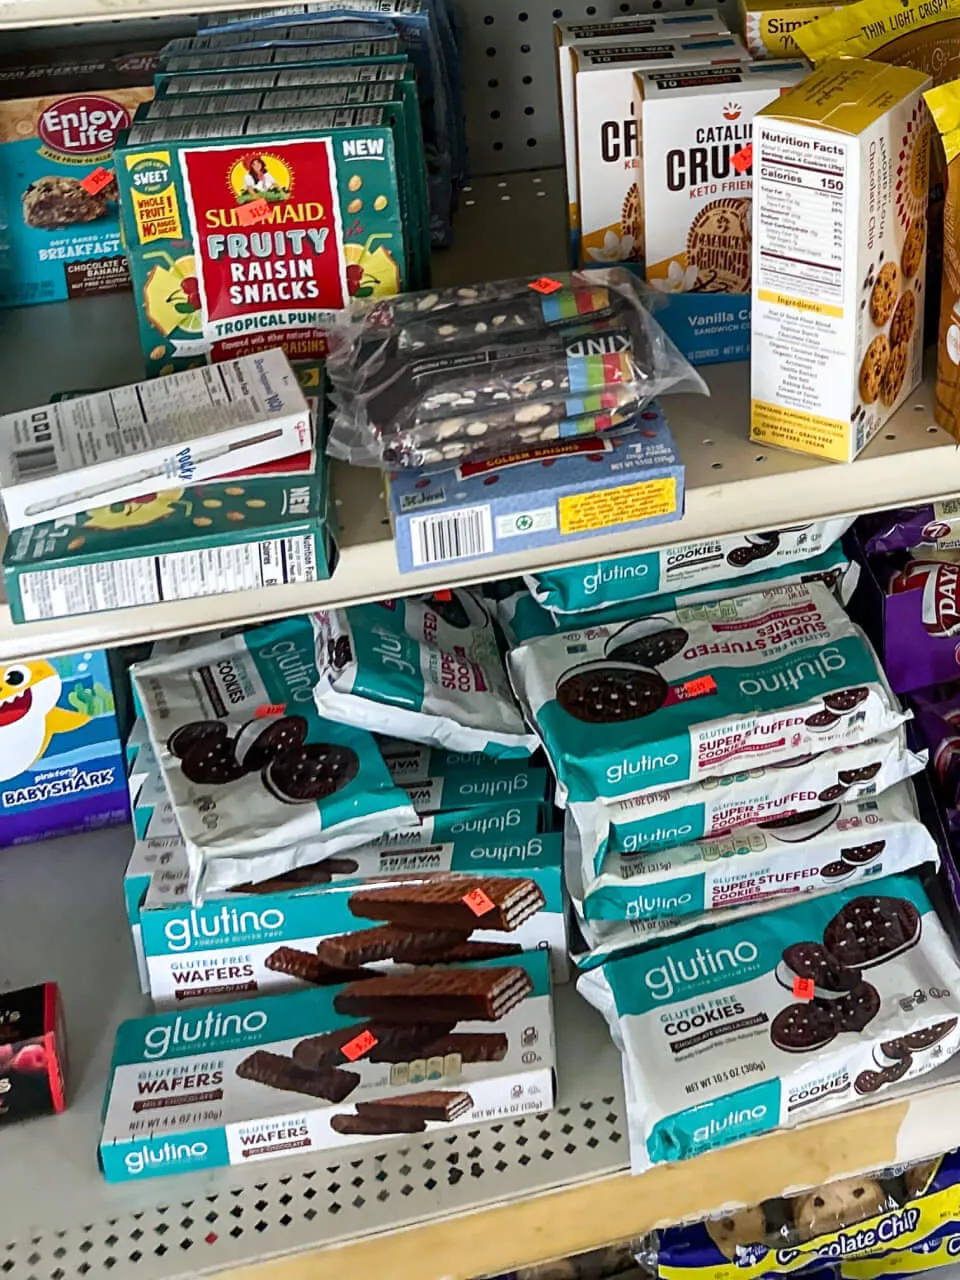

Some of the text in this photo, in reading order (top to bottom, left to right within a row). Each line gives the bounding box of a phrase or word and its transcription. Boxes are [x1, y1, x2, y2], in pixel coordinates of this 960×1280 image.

[862, 23, 886, 40] THIN.
[888, 8, 917, 30] LIGHT.
[43, 103, 125, 132] Enjoy
[63, 125, 113, 149] Life
[342, 139, 385, 156] NEW
[760, 130, 845, 156] Nutrition Facts
[133, 169, 169, 185] SWEET
[760, 167, 844, 192] Calories 150
[137, 196, 165, 210] WHOLE
[689, 184, 718, 199] KETO
[142, 222, 158, 238] NO
[207, 228, 330, 261] FRUITY
[230, 258, 314, 283] RAISIN
[229, 278, 320, 306] SNACKS
[215, 313, 288, 337] TROPICAL
[688, 311, 735, 327] Vanilla
[566, 335, 633, 357] KIND
[667, 543, 723, 565] COOKIES
[583, 562, 649, 595] glutino
[683, 632, 783, 659] STUFFED
[739, 646, 847, 696] glutino
[699, 716, 806, 752] SUPER STUFFED
[606, 750, 679, 783] glutino
[3, 787, 48, 808] BABY
[712, 866, 821, 895] SUPER STUFFED
[164, 907, 285, 951] glutino
[170, 954, 252, 972] GLUTEN FREE
[172, 964, 254, 985] WAFERS
[644, 939, 759, 1001] glutino
[659, 994, 738, 1024] GLUTEN FREE
[663, 1002, 746, 1038] COOKIES
[143, 1009, 269, 1061] glutino
[137, 1071, 225, 1096] WAFERS
[788, 1072, 850, 1104] COOKIES
[692, 1102, 768, 1144] glutino
[239, 1126, 310, 1147] WAFERS
[124, 1140, 209, 1174] glutino
